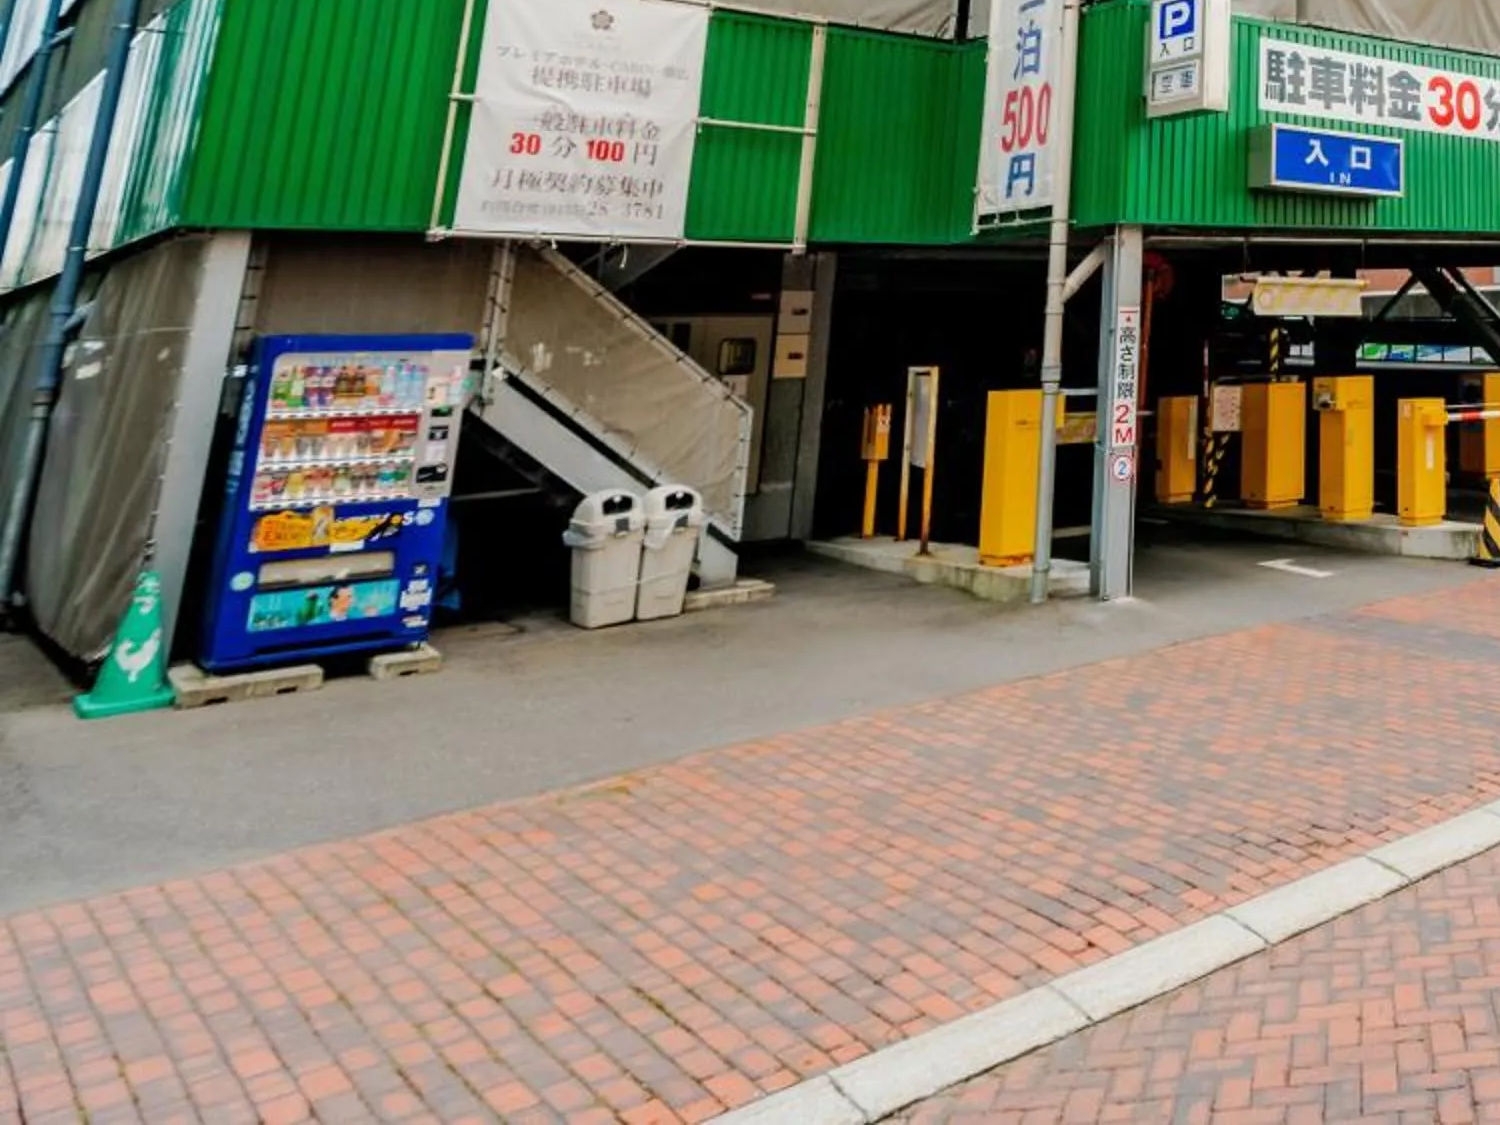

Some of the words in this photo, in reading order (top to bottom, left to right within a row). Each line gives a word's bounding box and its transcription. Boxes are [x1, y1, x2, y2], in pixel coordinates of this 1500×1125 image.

[1164, 1, 1193, 37] P
[1158, 37, 1195, 59] 入口
[509, 131, 541, 155] 30
[553, 135, 576, 159] 分
[585, 138, 625, 162] 100
[633, 141, 658, 166] 円
[1304, 138, 1372, 171] 入口
[1330, 172, 1351, 186] IN
[1117, 326, 1137, 399] 高さ制限
